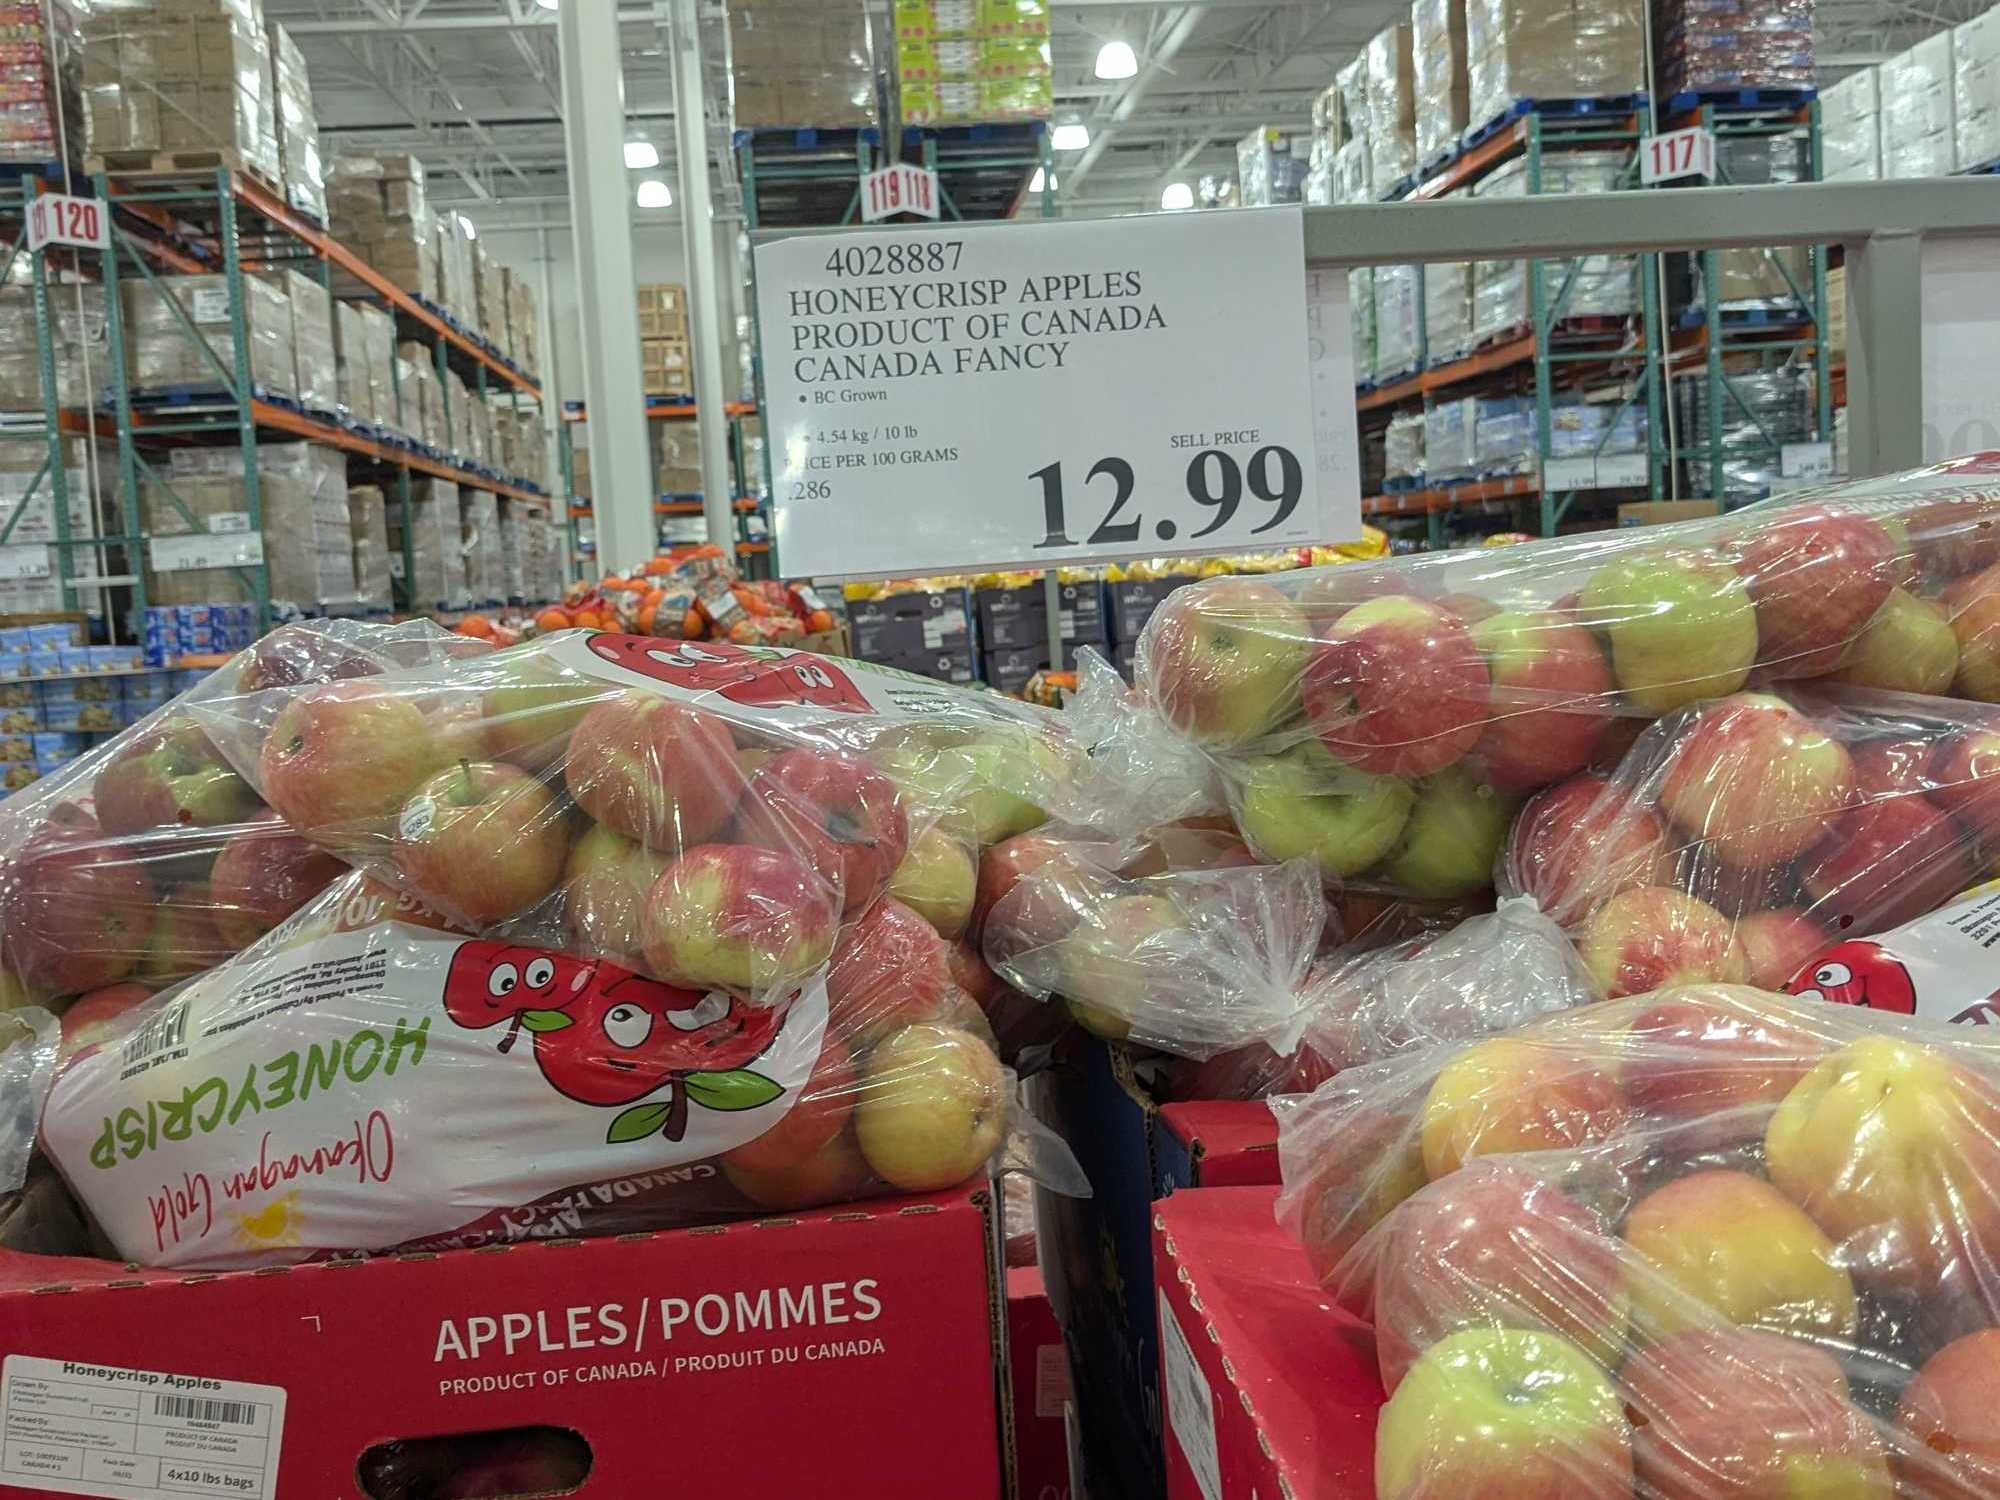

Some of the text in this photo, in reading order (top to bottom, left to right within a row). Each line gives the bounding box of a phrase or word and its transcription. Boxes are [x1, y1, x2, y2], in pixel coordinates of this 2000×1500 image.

[1650, 135, 1695, 175] 117
[869, 171, 900, 213] 119
[53, 200, 99, 241] 120
[825, 241, 964, 277] 4028887
[788, 270, 1142, 317] HONEYCRISP APPLES
[792, 304, 1168, 350] PRODUCT OF CANADA
[794, 342, 1070, 383] CANADA FANCY
[814, 389, 887, 404] BC Grown
[817, 430, 847, 444] 4.54
[852, 429, 869, 444] kg
[885, 426, 900, 439] 10
[905, 425, 918, 438] lb
[1170, 429, 1260, 448] SELL PRICE
[784, 448, 958, 470] PICE PER 100 GRAMS
[1028, 445, 1303, 549] 12.99
[89, 1016, 432, 1169] HONEYCRISP
[148, 1110, 393, 1252] Okanagan Gold
[591, 1163, 717, 1203] CANADA
[63, 1362, 222, 1390] Honeycrisp Apples
[439, 1370, 536, 1396] PRODUCT
[543, 1368, 570, 1387] OF
[575, 1360, 657, 1383] CANADA
[675, 1349, 764, 1374] PRODUIT
[771, 1346, 798, 1364] DU
[804, 1338, 886, 1360] CANADA
[167, 1469, 254, 1490] 4x10 lbs bags
